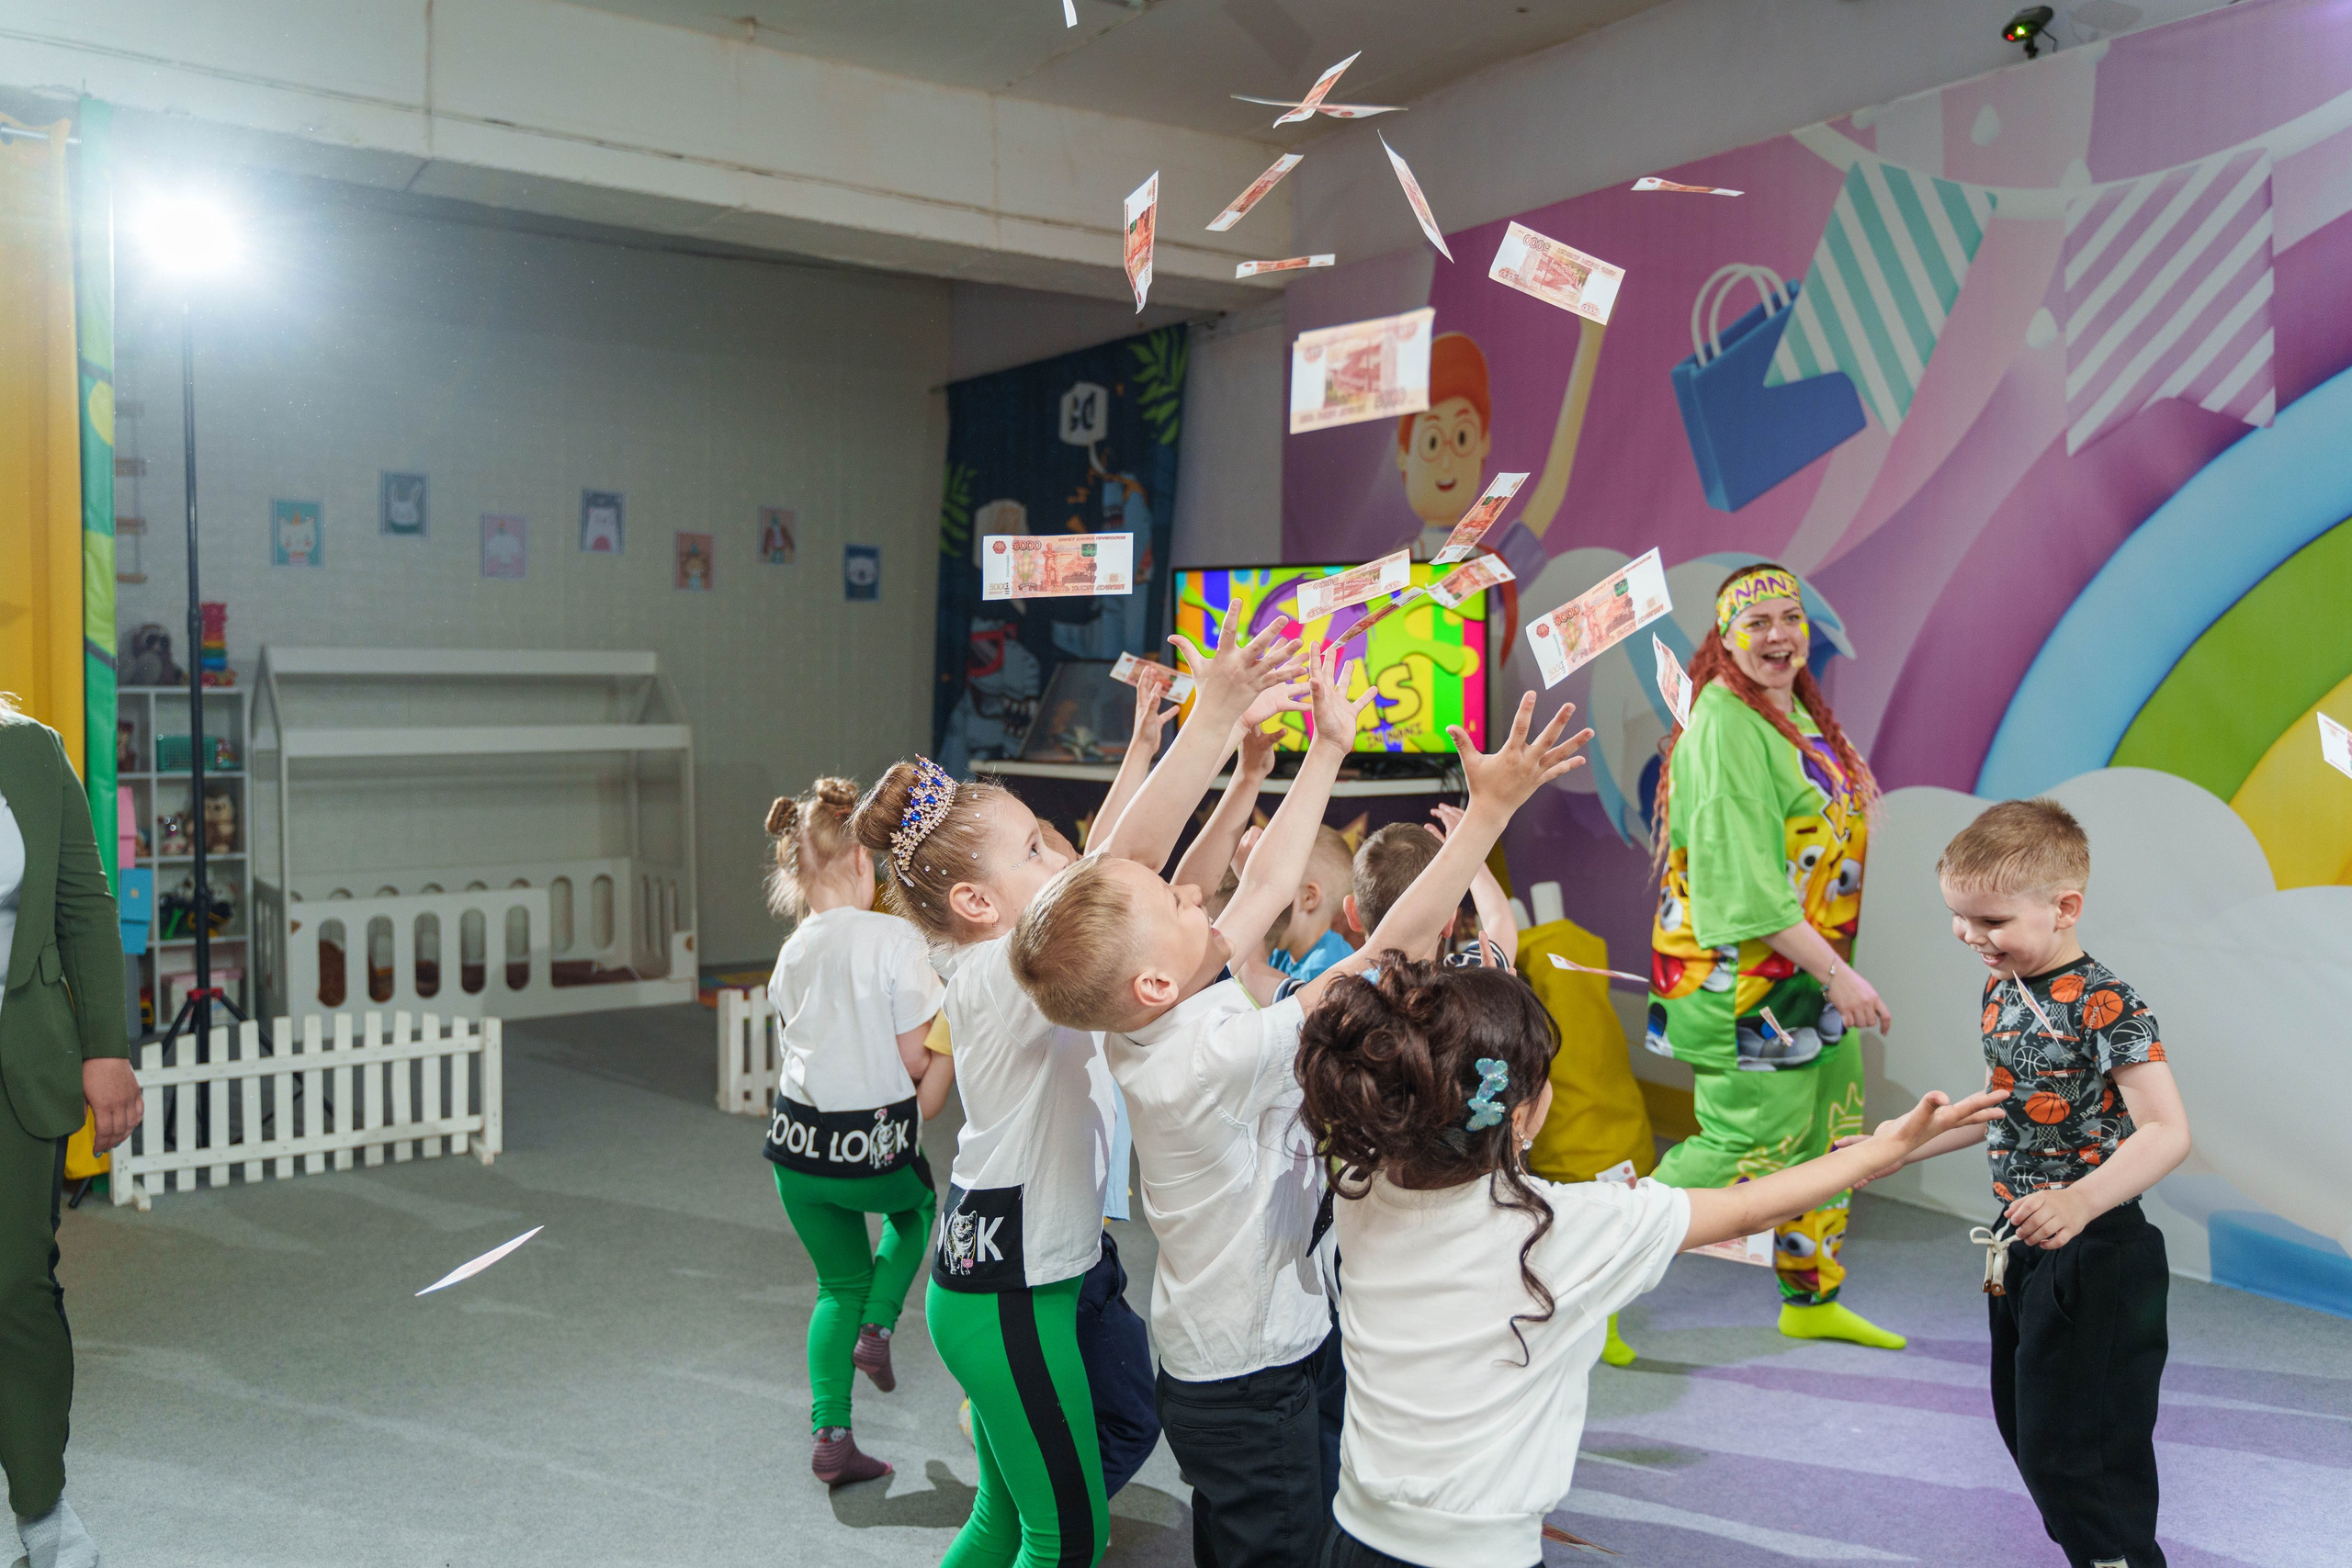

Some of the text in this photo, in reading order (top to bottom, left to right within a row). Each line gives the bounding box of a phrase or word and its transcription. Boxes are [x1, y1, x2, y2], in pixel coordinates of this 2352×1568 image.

[1522, 234, 1552, 254] 5000
[1012, 540, 1042, 551] 5000
[1553, 604, 1580, 626] 5000
[2079, 1101, 2104, 1119] BASK
